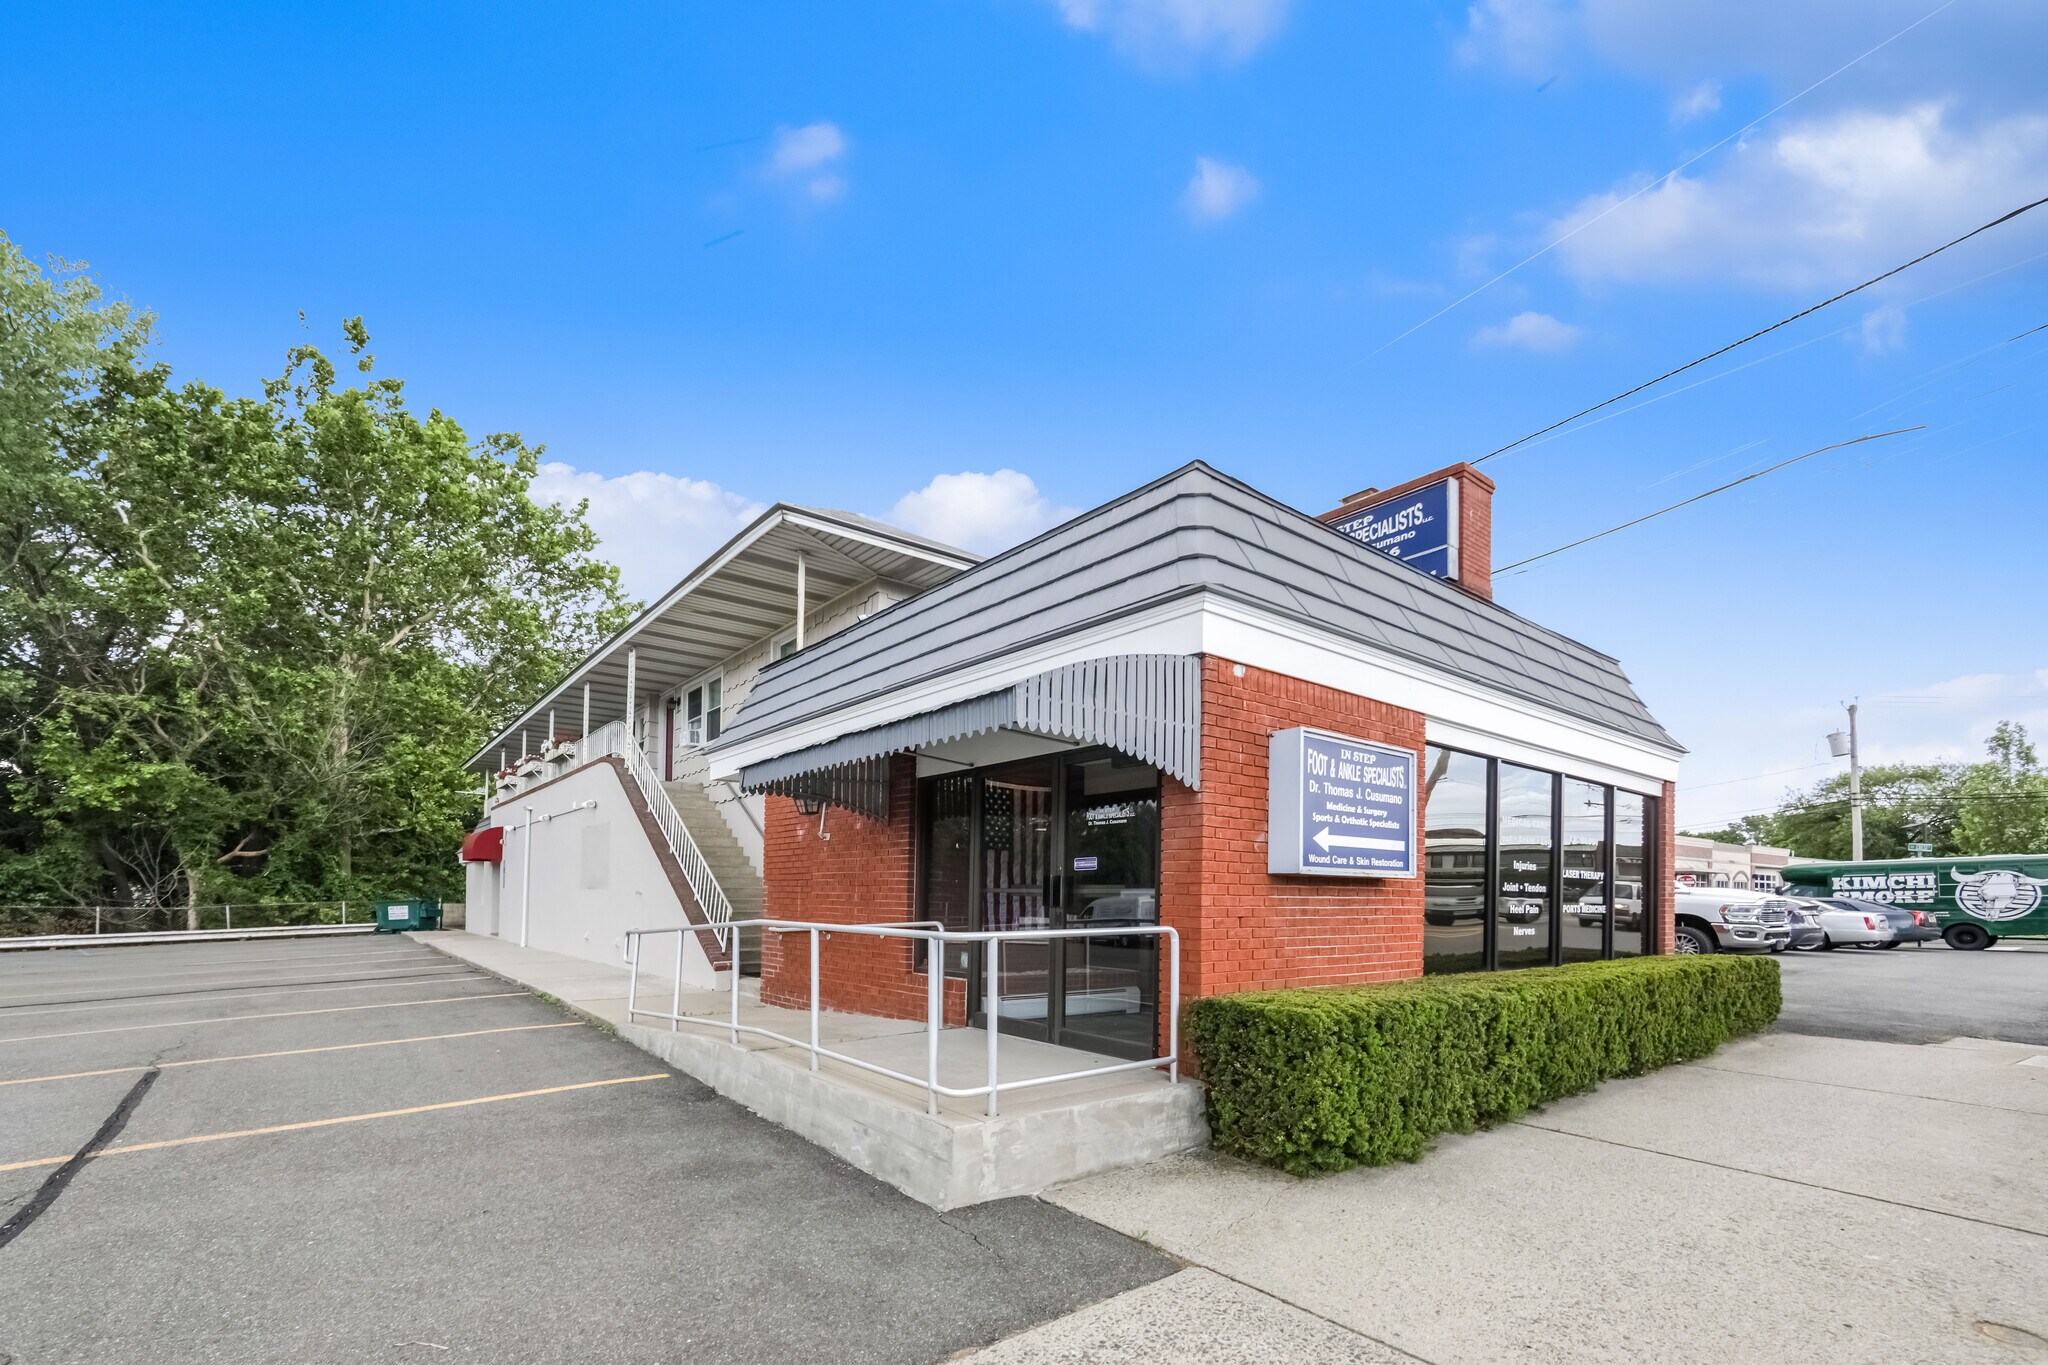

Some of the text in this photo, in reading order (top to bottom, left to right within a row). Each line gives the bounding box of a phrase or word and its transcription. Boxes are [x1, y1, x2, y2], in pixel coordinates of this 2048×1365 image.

[1336, 515, 1374, 533] STEP
[1372, 530, 1416, 549] umano
[1340, 748, 1376, 764] IN STEP
[1307, 748, 1404, 788] FOOT & ANKLE SPECIALISTS
[1309, 780, 1402, 804] Dr. Thomas J. Cusumano
[1326, 801, 1388, 818] Medicine & Surgery
[1312, 812, 1400, 830] Sports & Orthotic Specialists
[1308, 854, 1404, 868] Wound Care & Skin Restoration
[1514, 860, 1536, 872] Injuries
[1562, 870, 1604, 880] LASER THERAPY
[1832, 875, 1936, 890] KIMCHI
[1502, 882, 1546, 892] Joint Tendon
[1510, 904, 1538, 914] Heel Pain
[1562, 904, 1606, 914] PORTS MEDICINE
[1514, 926, 1536, 936] Nerves
